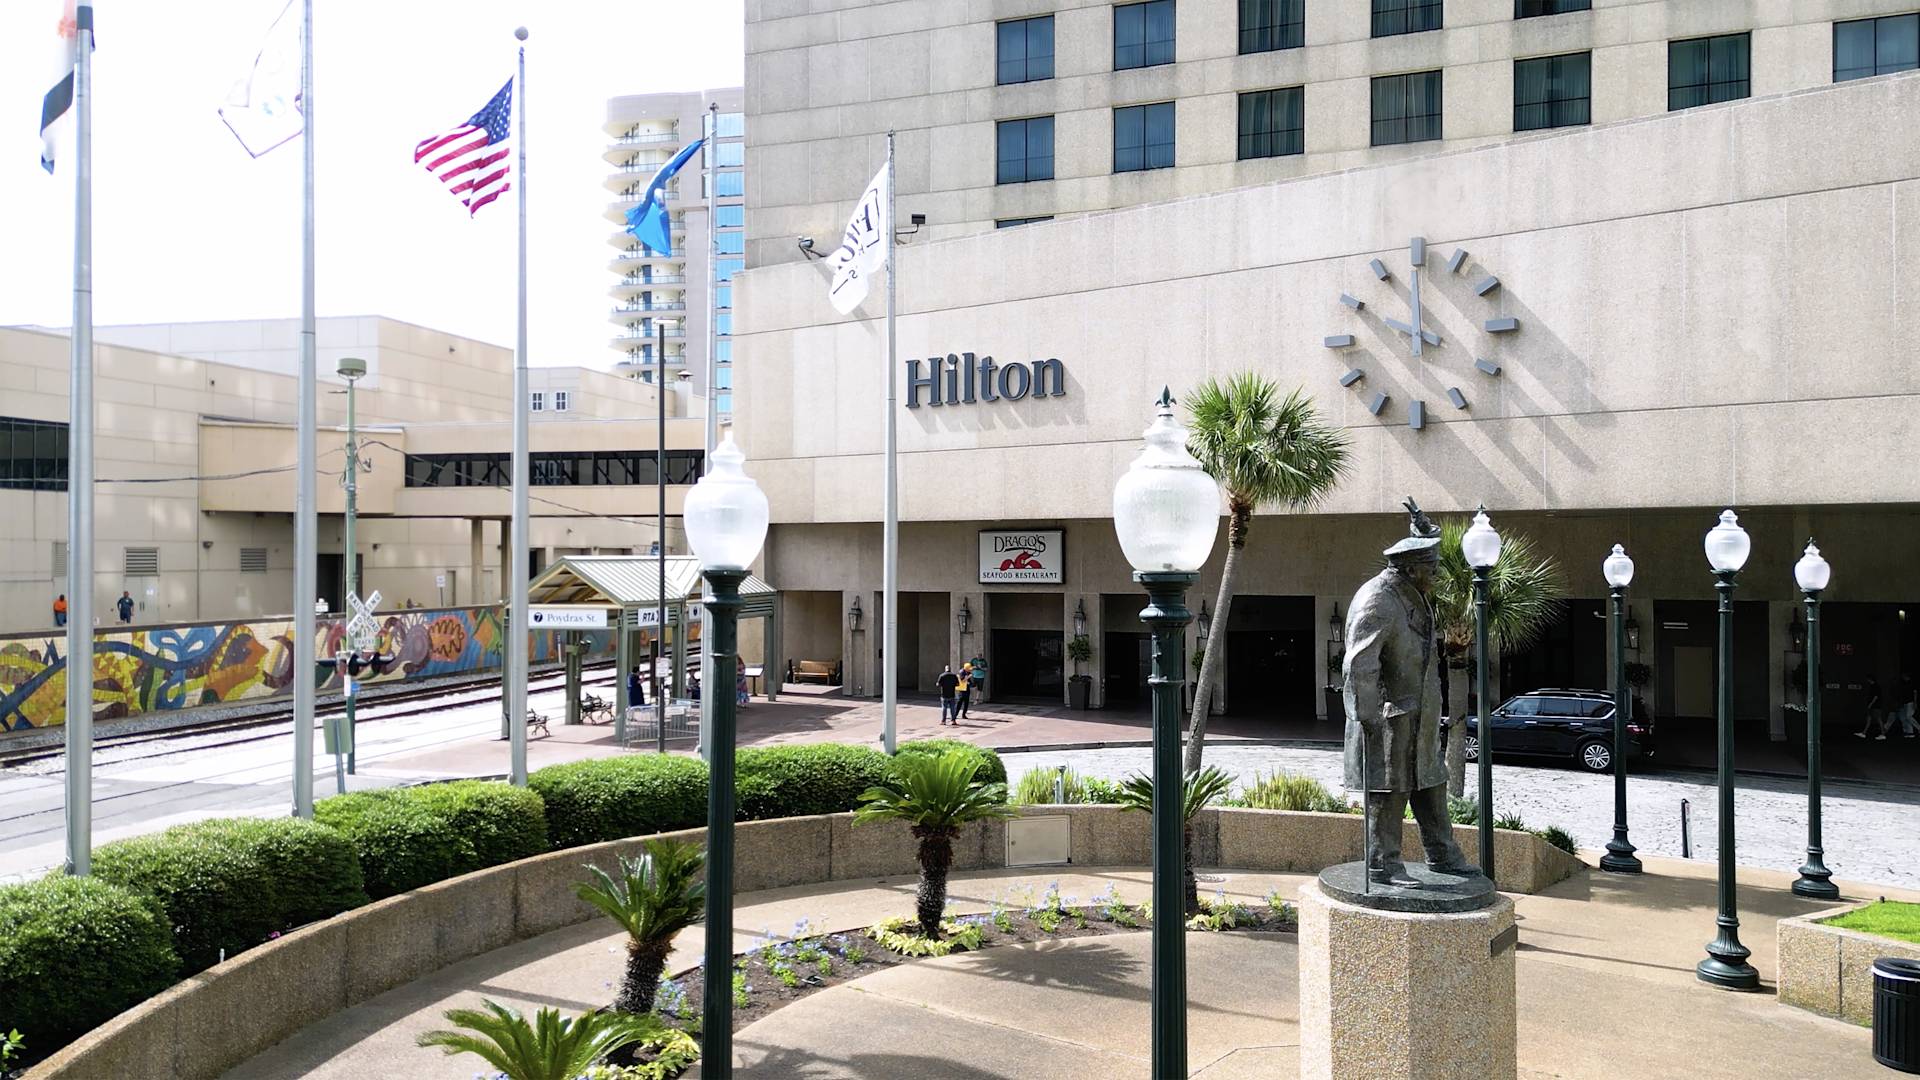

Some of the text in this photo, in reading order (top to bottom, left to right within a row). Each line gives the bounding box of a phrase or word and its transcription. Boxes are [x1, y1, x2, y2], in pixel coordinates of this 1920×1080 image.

[905, 352, 1066, 408] Hilton
[994, 534, 1046, 553] DRAGO'S
[982, 571, 1057, 579] SEAFOOD RESTAURANT
[547, 613, 584, 624] Poydras
[642, 612, 655, 622] RTA
